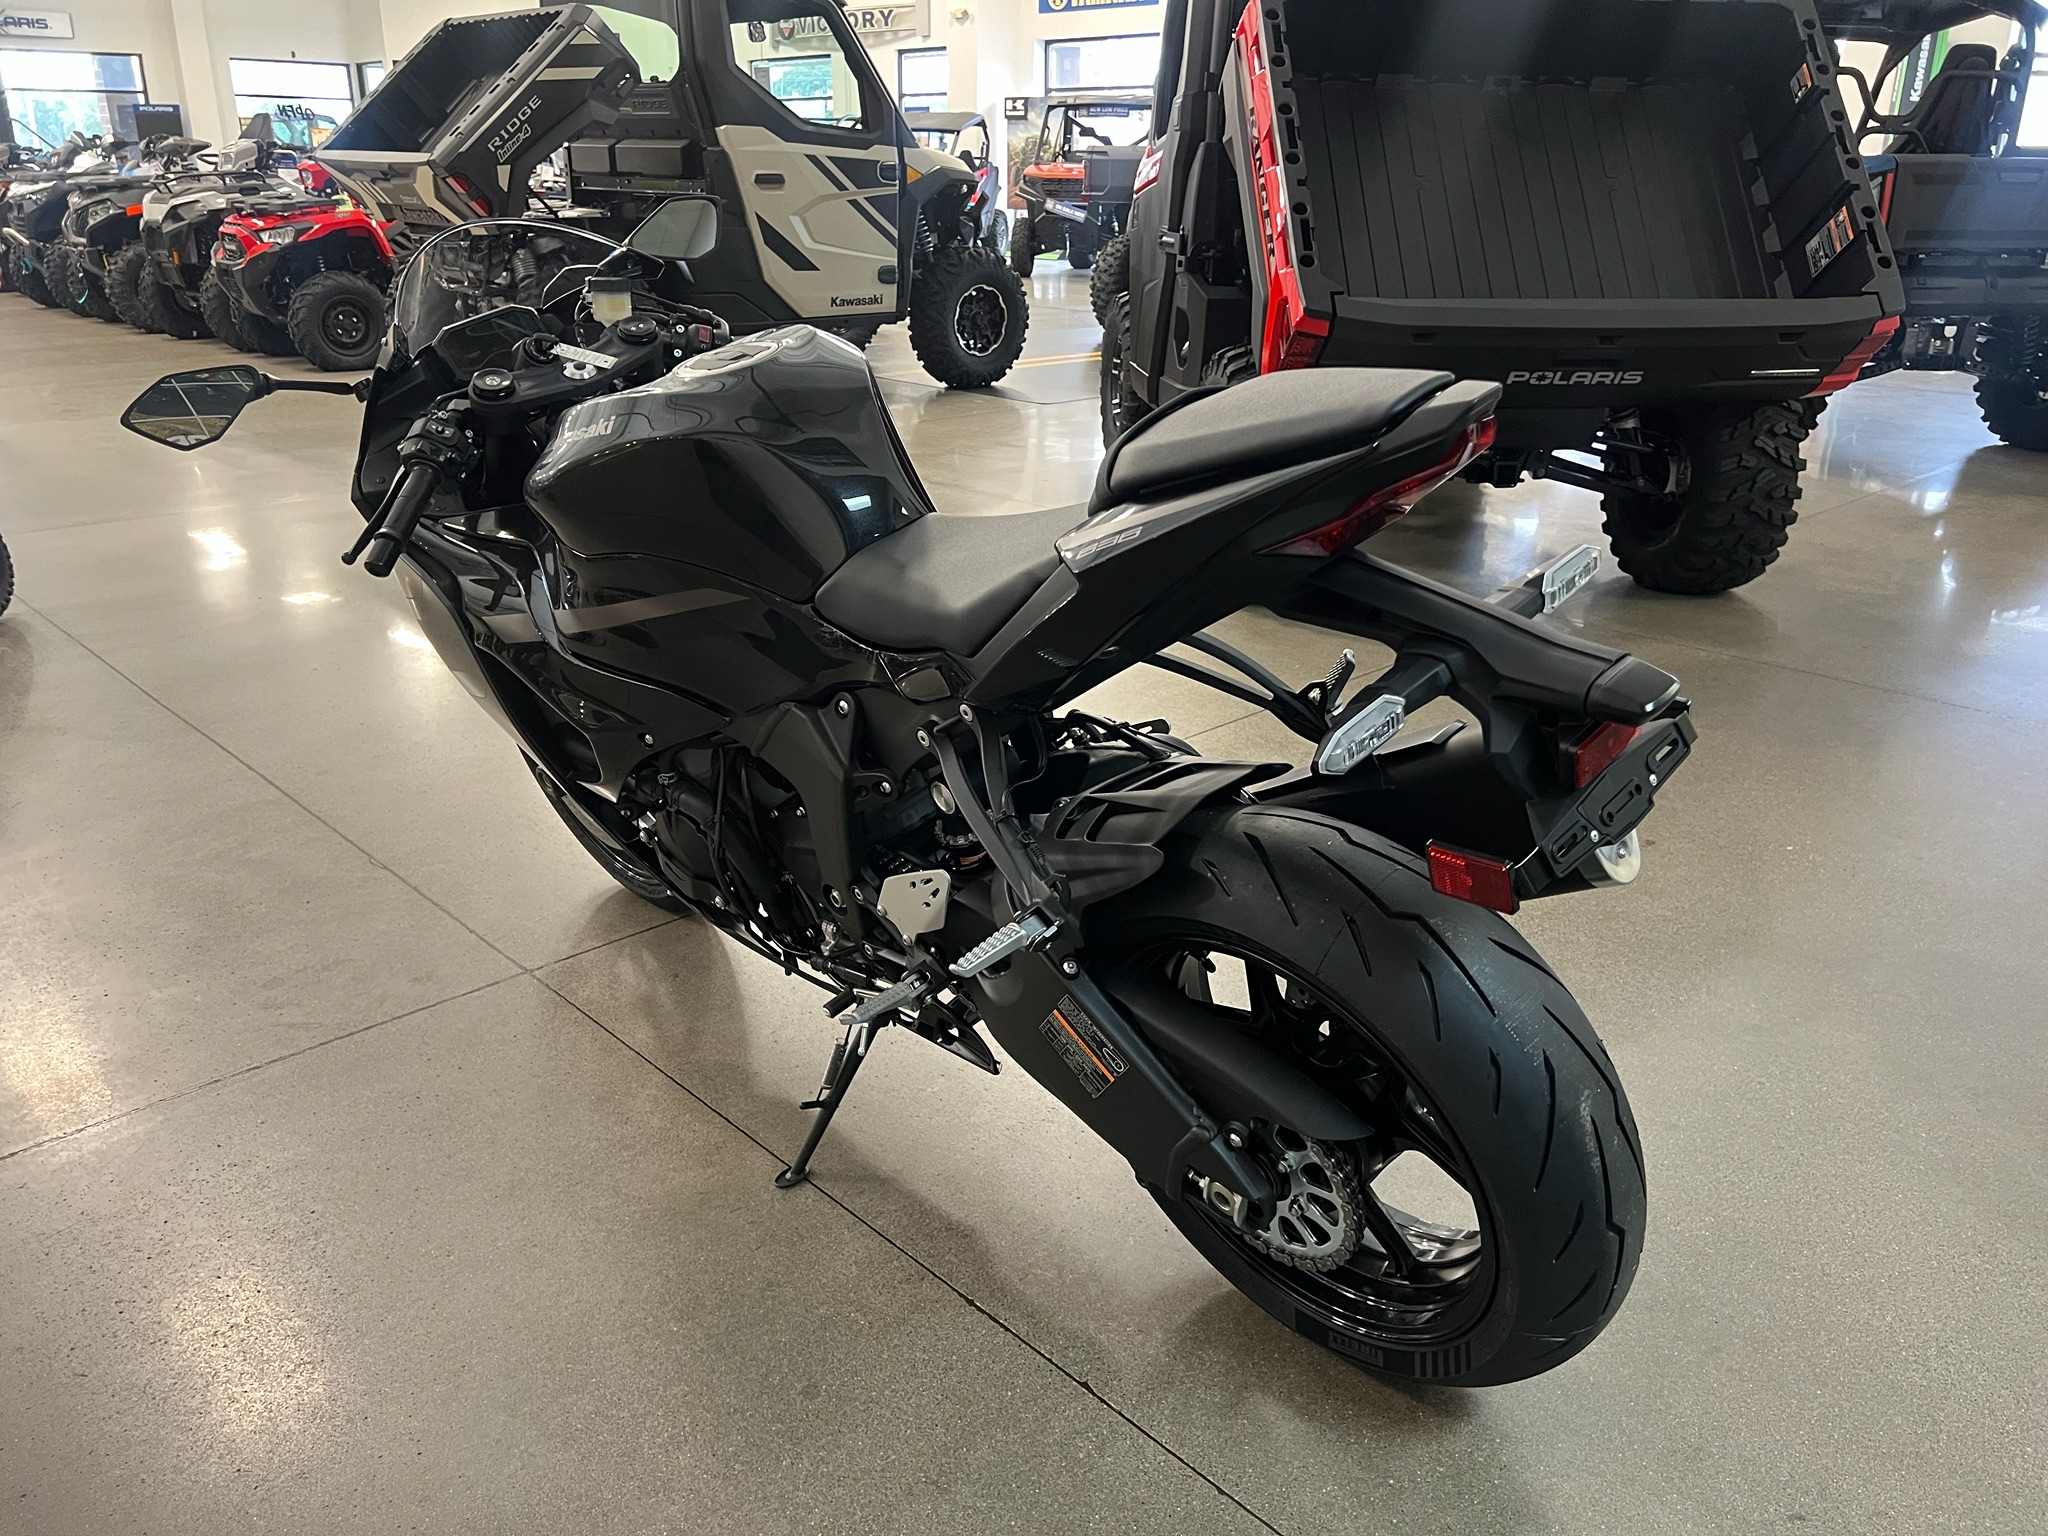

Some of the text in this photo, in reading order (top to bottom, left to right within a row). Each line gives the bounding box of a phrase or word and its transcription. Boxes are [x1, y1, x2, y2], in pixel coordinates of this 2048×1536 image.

[0, 16, 49, 29] ARIS
[801, 9, 894, 34] VICORY
[488, 95, 542, 152] RIDGE
[1250, 106, 1275, 258] RANGER
[830, 294, 883, 307] Kawasaki
[1506, 371, 1644, 385] POLARIS
[573, 415, 616, 440] saki
